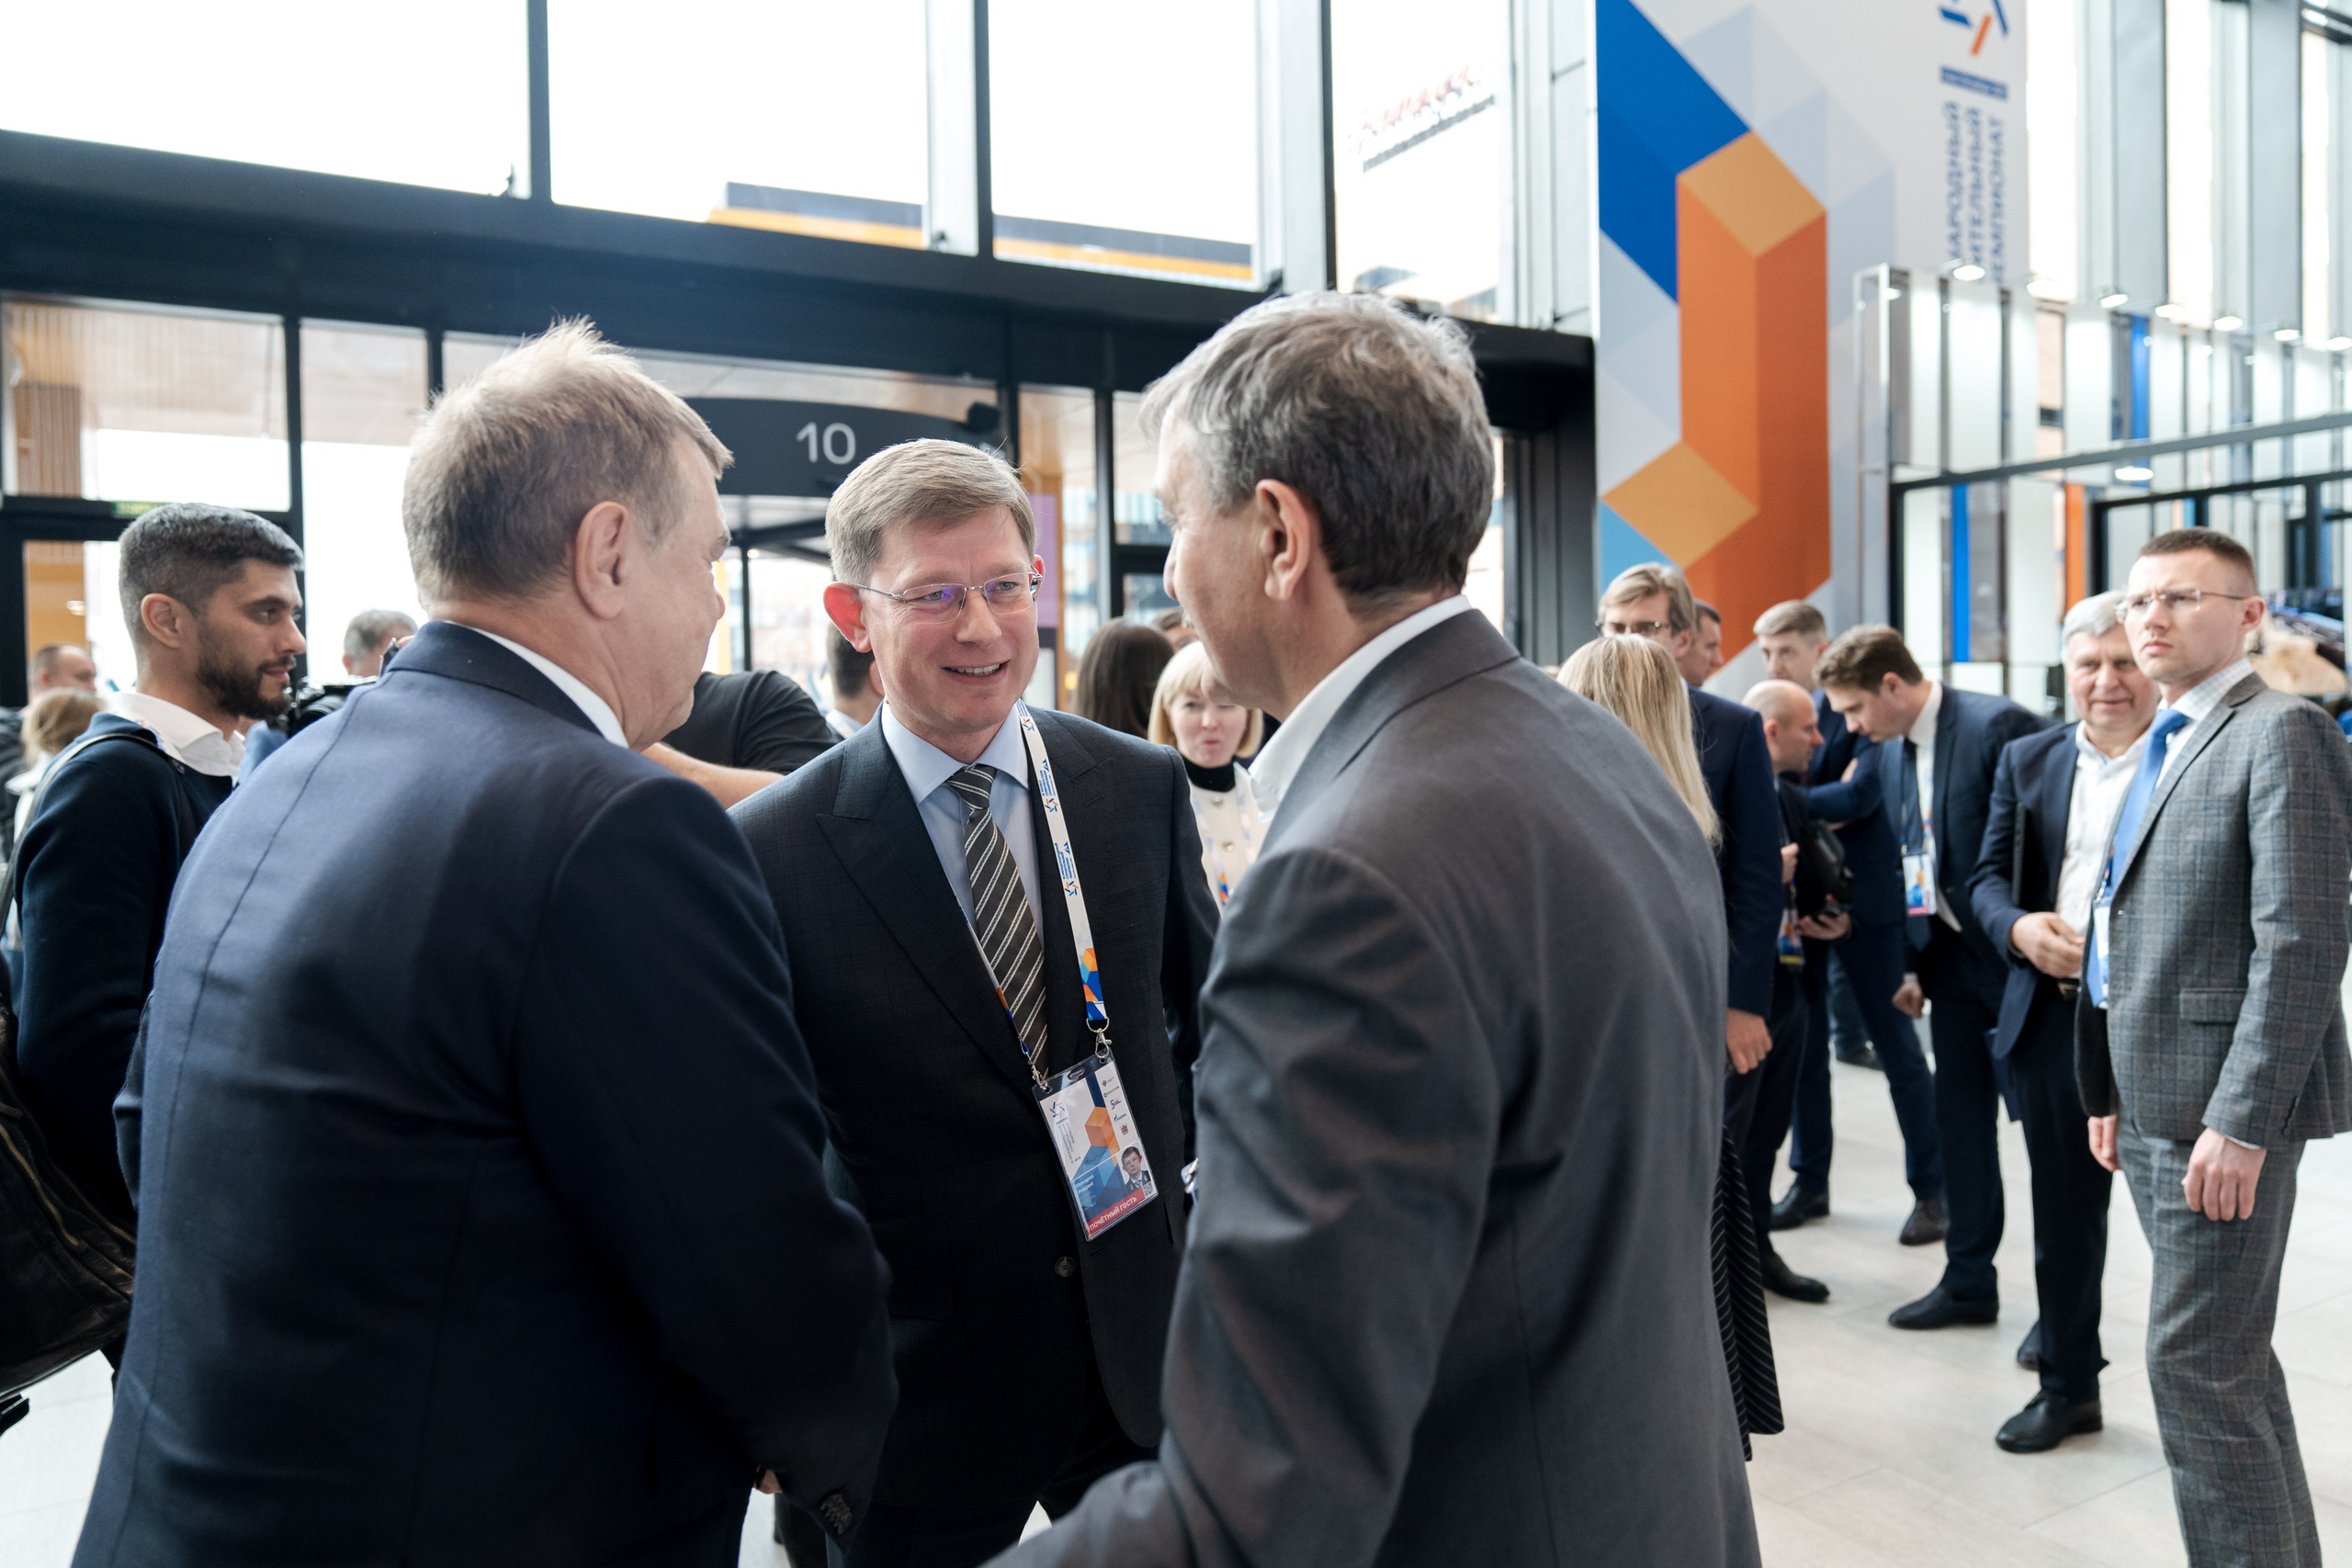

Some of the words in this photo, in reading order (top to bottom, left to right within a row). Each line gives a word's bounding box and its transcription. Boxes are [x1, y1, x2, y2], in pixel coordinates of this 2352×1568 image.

[796, 422, 856, 465] 10
[1089, 1206, 1120, 1231] ПОЧЁТНЫЙ
[1120, 1197, 1137, 1211] ГОСТЬ
